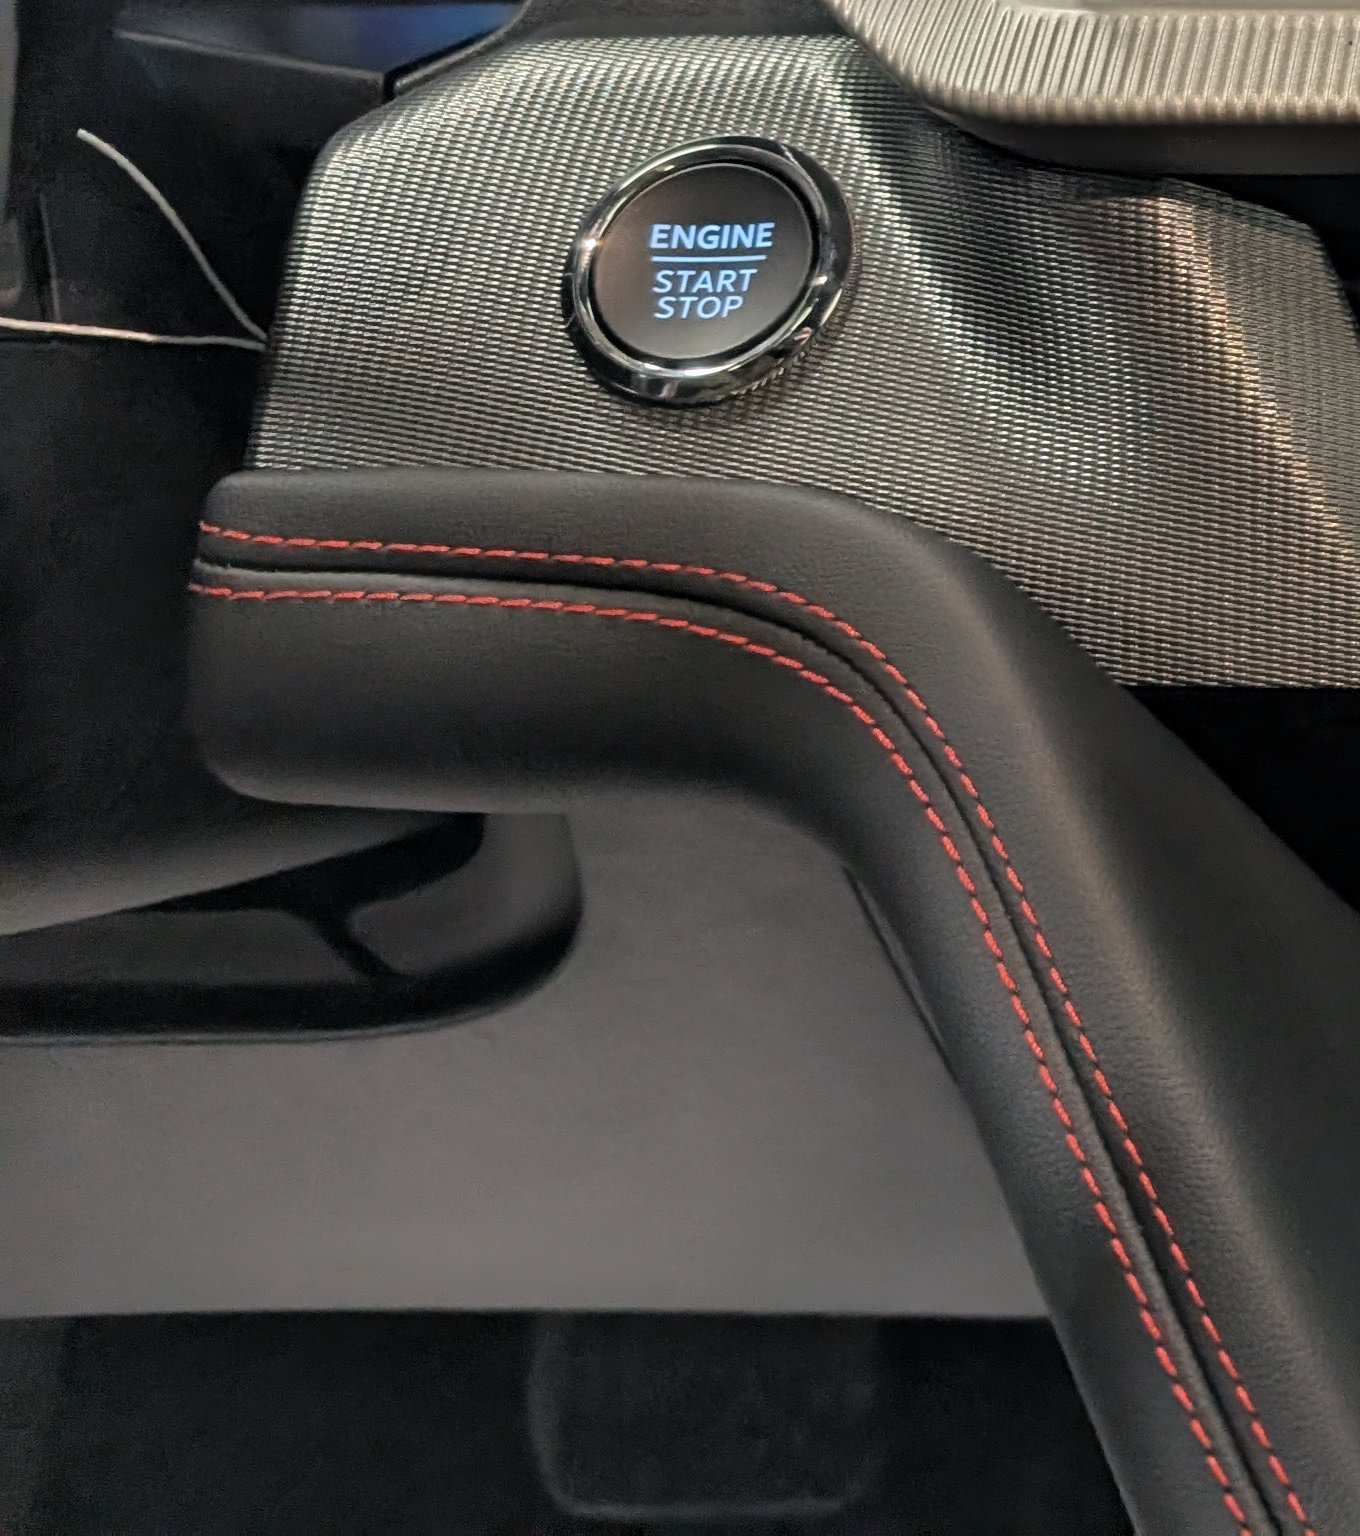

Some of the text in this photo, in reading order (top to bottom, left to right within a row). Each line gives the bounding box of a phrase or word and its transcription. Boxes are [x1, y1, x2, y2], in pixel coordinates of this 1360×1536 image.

[648, 222, 775, 250] ENGINE
[652, 268, 758, 294] START
[653, 295, 744, 320] STOP
